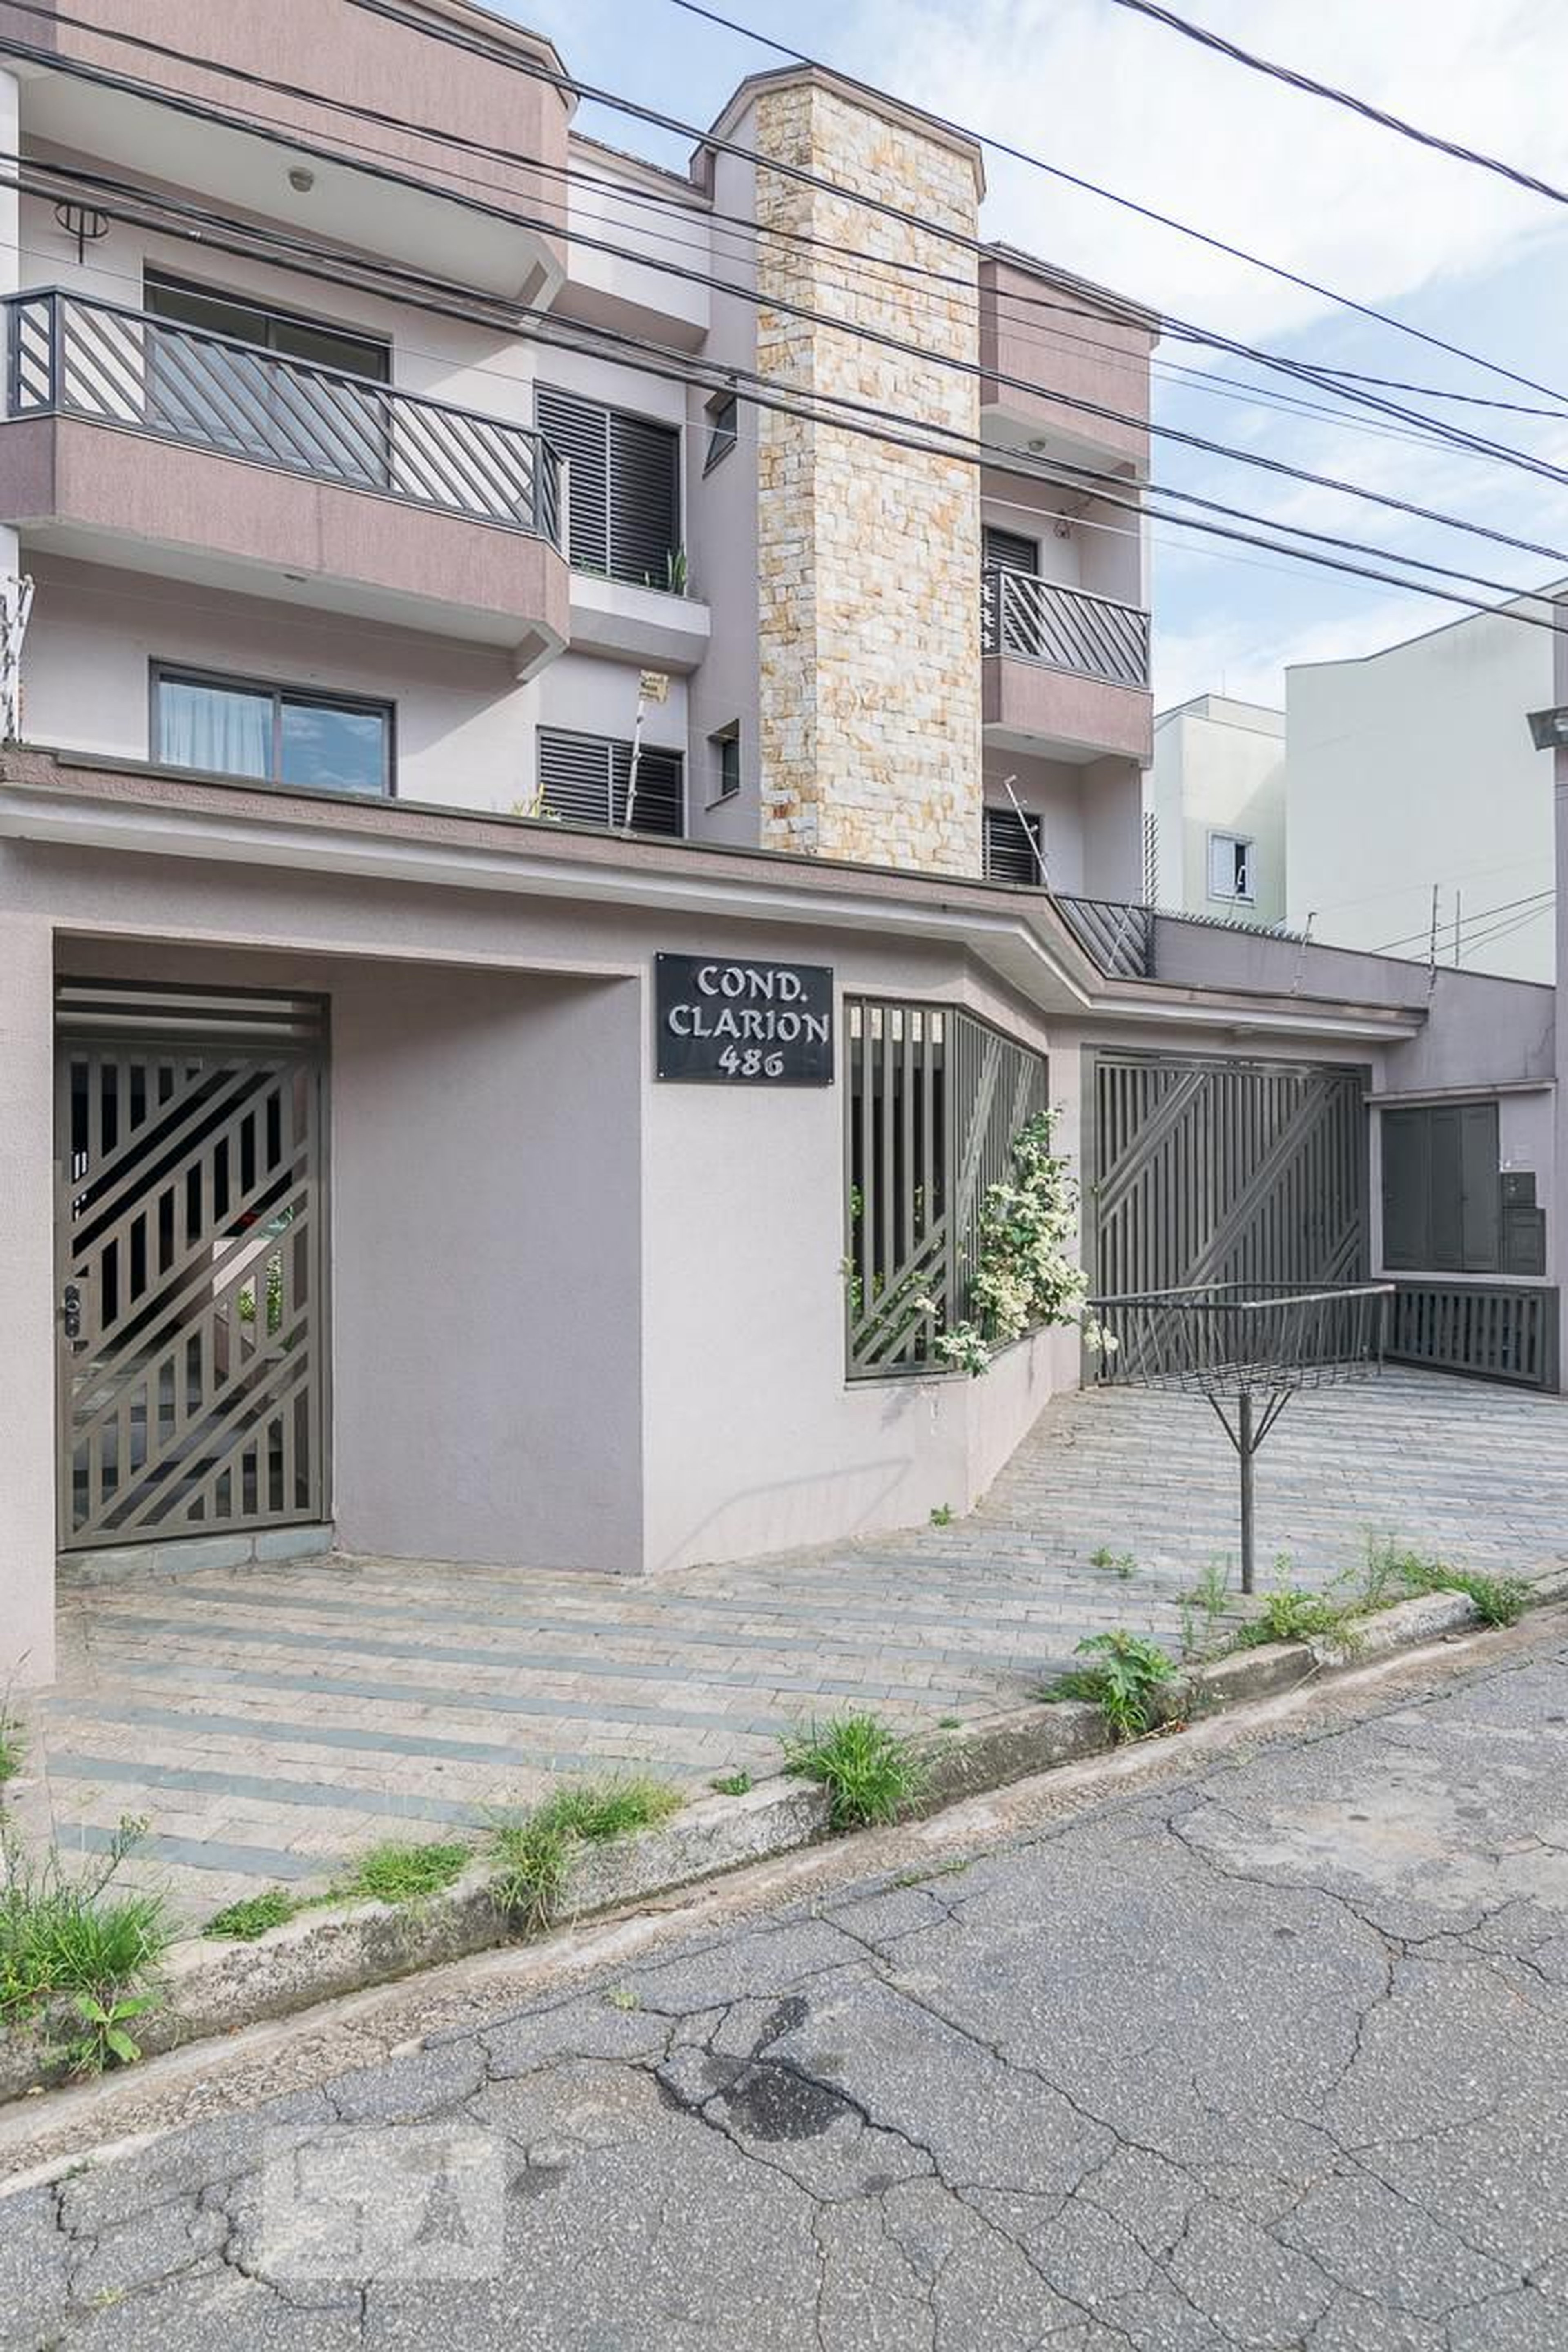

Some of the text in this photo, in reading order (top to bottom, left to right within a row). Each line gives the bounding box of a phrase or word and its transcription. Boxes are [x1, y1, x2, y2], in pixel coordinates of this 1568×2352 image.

[698, 966, 808, 1002] COND.
[668, 1004, 829, 1044] CLARION
[718, 1045, 784, 1076] 486
